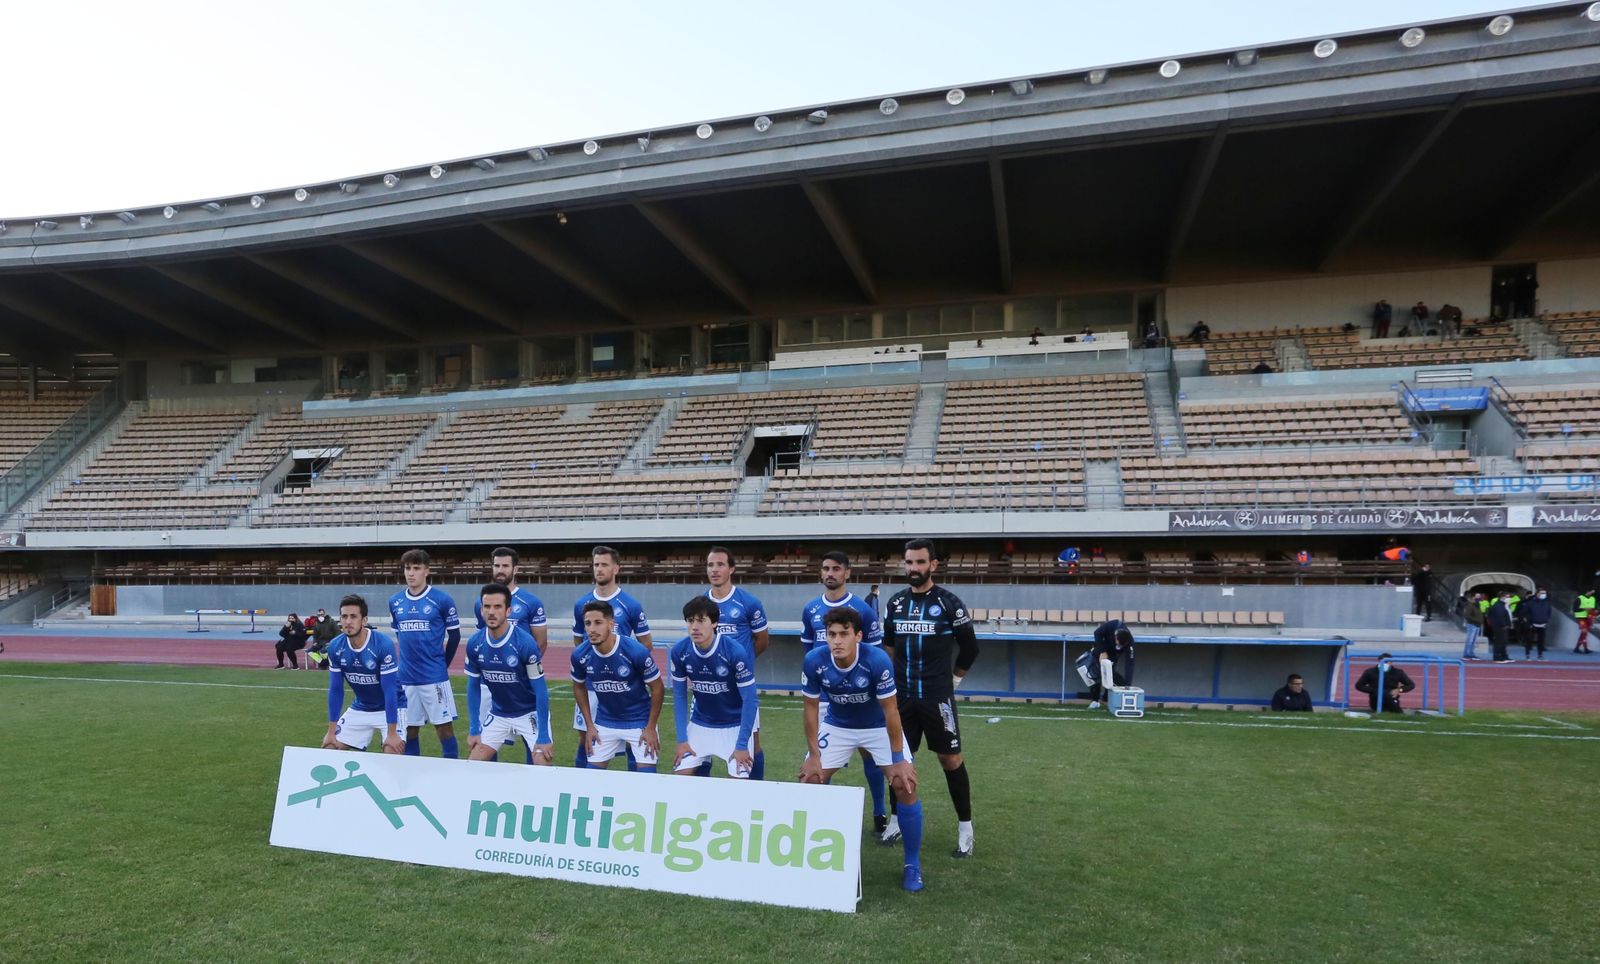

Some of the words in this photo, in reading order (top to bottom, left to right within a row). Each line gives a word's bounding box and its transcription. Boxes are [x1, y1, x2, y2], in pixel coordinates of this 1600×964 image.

[1172, 513, 1231, 528] Andalucía
[1262, 514, 1317, 525] ALIMENTOS
[1321, 514, 1333, 524] DE
[1338, 512, 1382, 524] CALIDAD
[1413, 510, 1478, 525] Andalucía
[896, 623, 935, 632] RANABE
[817, 732, 830, 749] 6
[467, 792, 845, 872] multialgaida
[475, 848, 554, 869] CORREDURÍA
[557, 858, 575, 870] DE
[577, 859, 640, 878] SEGUROS
